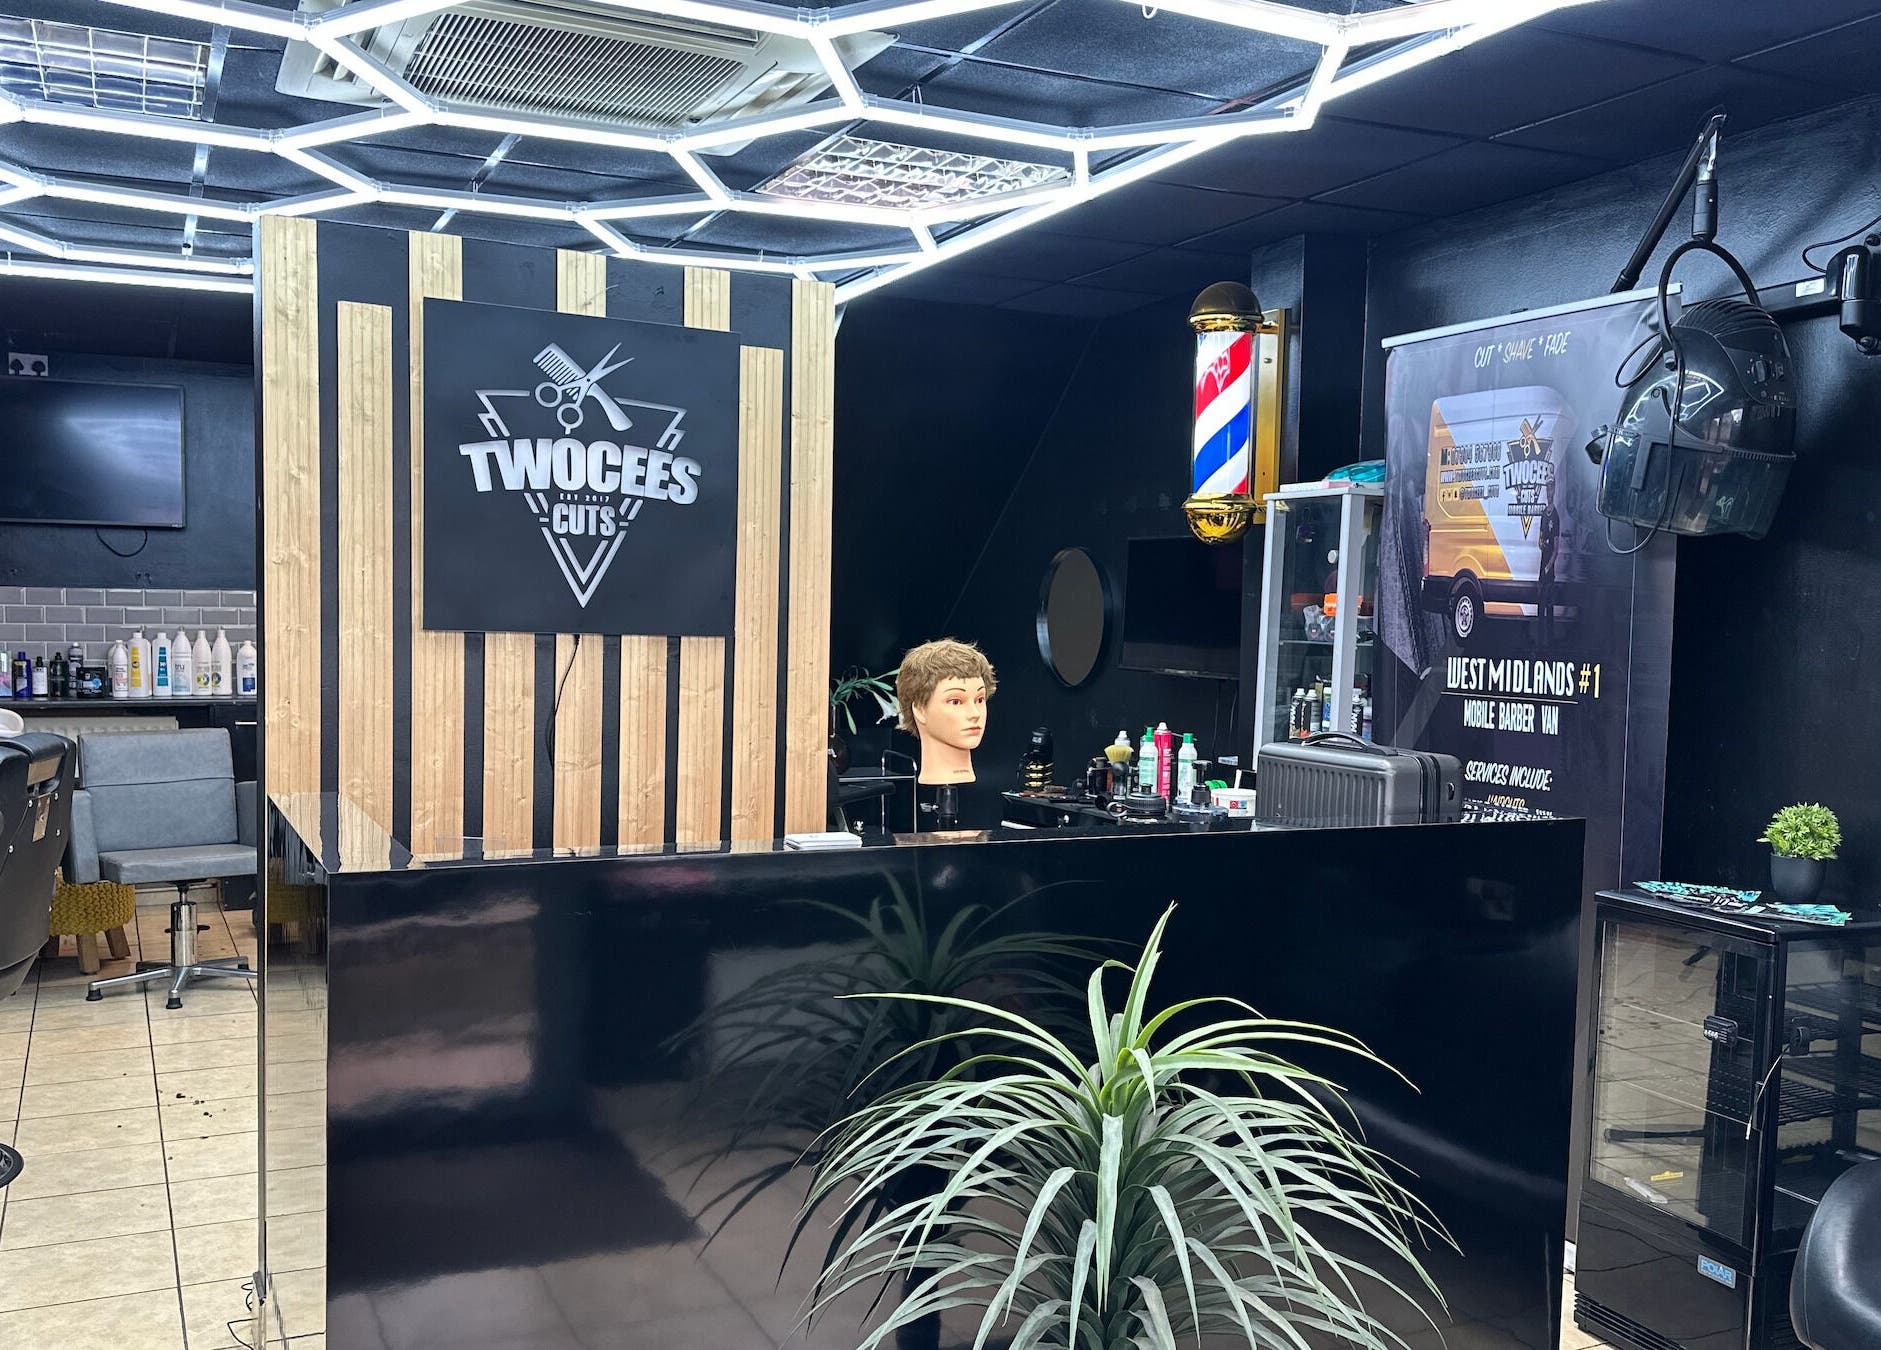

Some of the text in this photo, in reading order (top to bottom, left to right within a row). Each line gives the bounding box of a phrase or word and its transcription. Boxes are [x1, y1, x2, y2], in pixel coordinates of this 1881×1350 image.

[1474, 330, 1572, 369] CUT SHAVE FADE
[459, 438, 702, 505] TWOCEES
[585, 494, 610, 503] 2017
[552, 502, 616, 537] CUTS
[1446, 656, 1601, 699] WEST MIDLANDS #1
[1463, 699, 1559, 736] MOBILE BARBER VAN
[1464, 759, 1554, 792] SERVICES INCLUDE:
